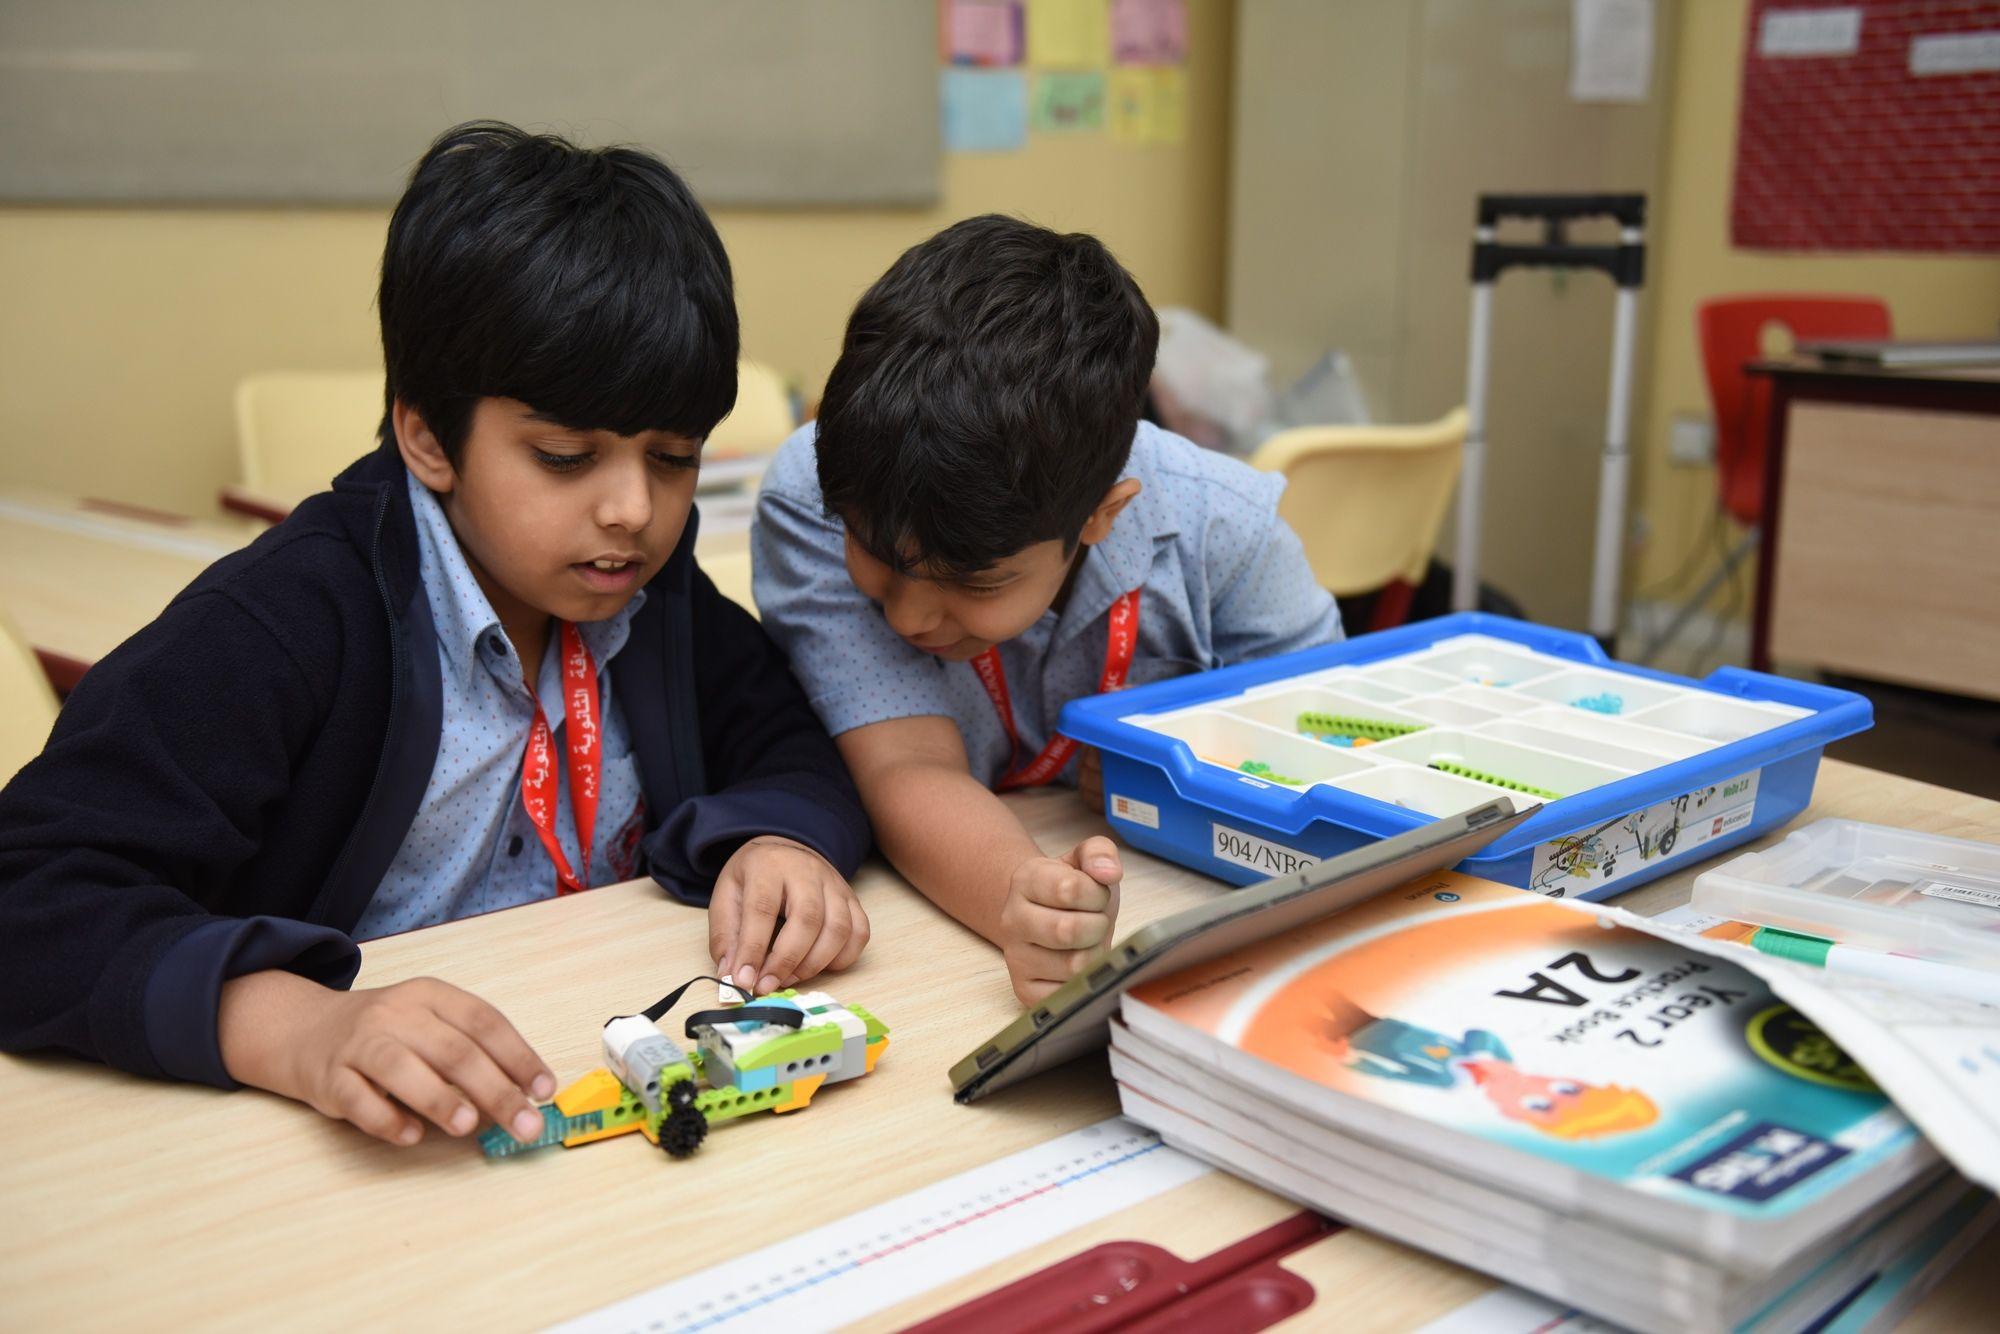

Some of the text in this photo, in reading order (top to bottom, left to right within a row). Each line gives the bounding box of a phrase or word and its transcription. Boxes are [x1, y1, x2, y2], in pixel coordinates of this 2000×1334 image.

[1493, 951, 1642, 1007] 2A
[1612, 958, 1712, 1008] Practice
[1614, 984, 1747, 1048] Year 2
